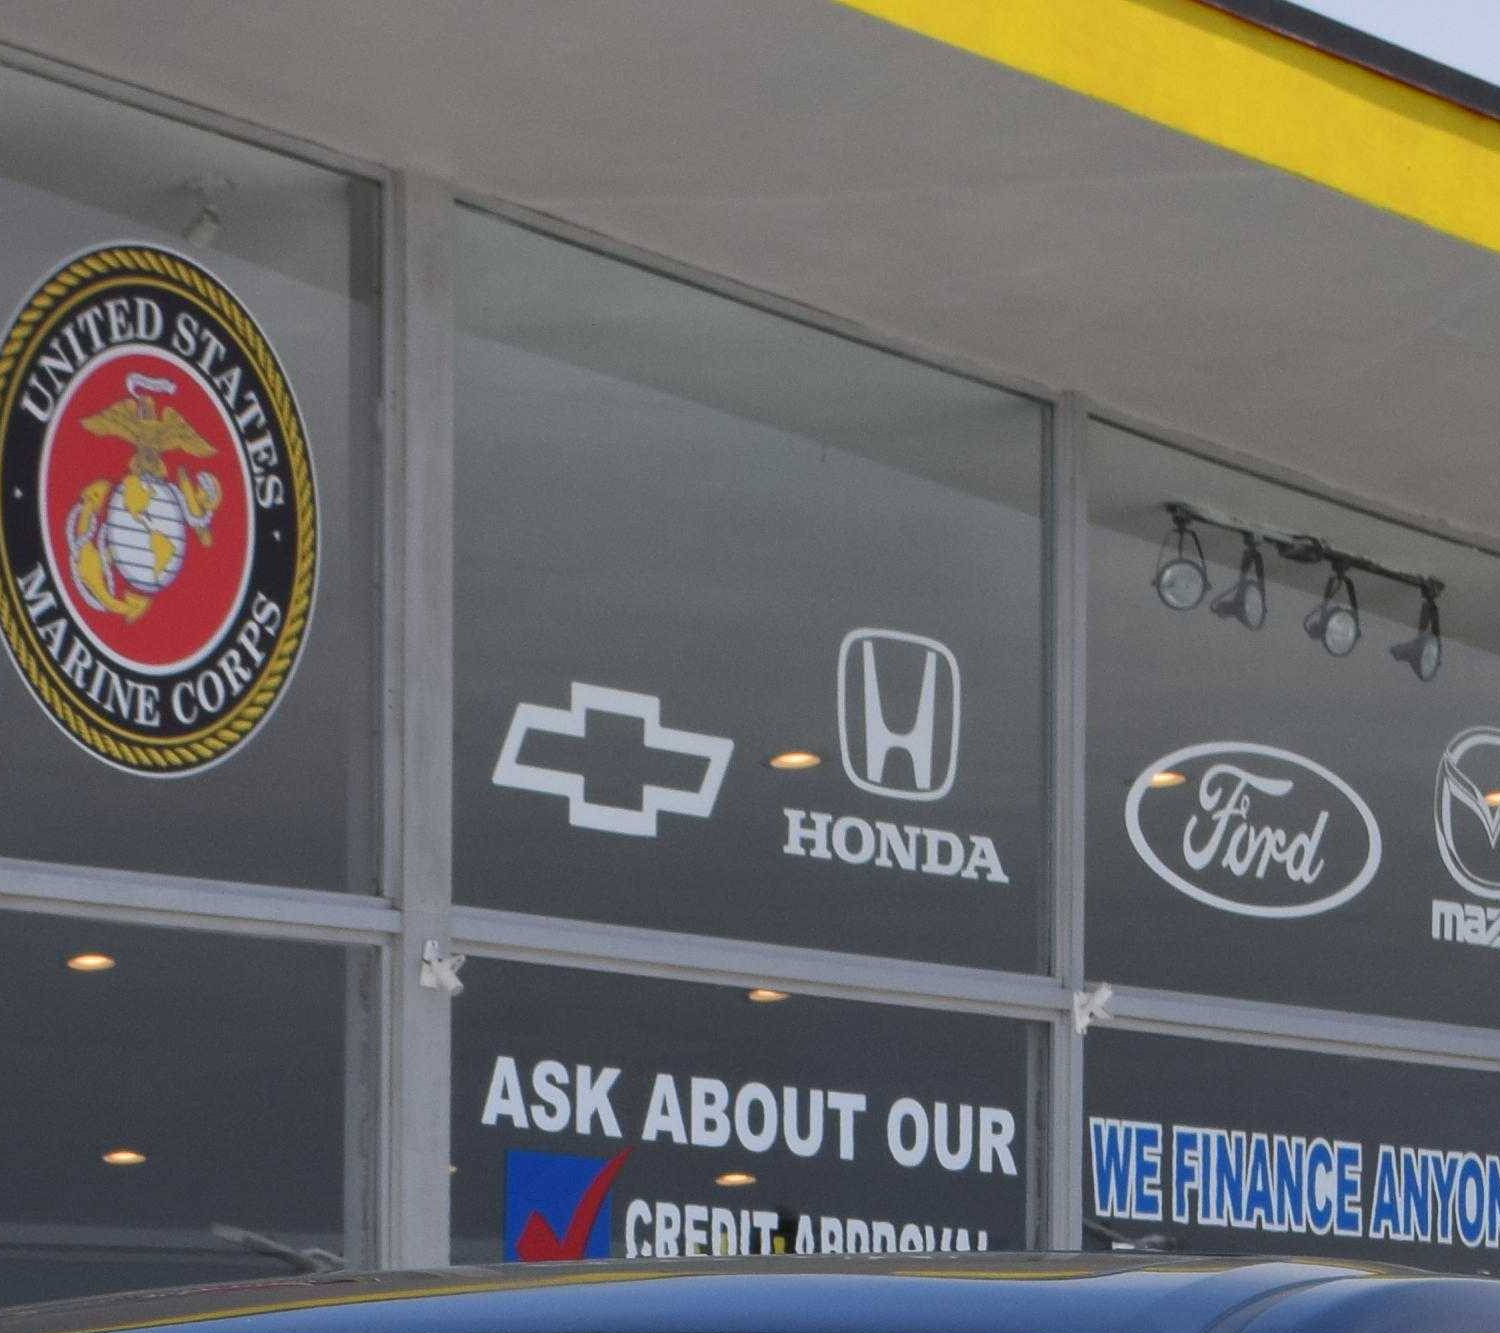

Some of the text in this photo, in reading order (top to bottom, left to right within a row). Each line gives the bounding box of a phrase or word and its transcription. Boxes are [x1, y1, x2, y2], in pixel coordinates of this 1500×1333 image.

[20, 296, 285, 513] UNITED STATES
[14, 561, 282, 729] MARINE CORPS
[784, 808, 1009, 885] HONDA
[1182, 763, 1326, 887] Ford
[481, 1054, 1020, 1176] ASK ABOUT OUR
[1091, 1115, 1164, 1220] WE
[1172, 1125, 1365, 1237] FINANCE
[626, 1199, 778, 1258] CREDIT
